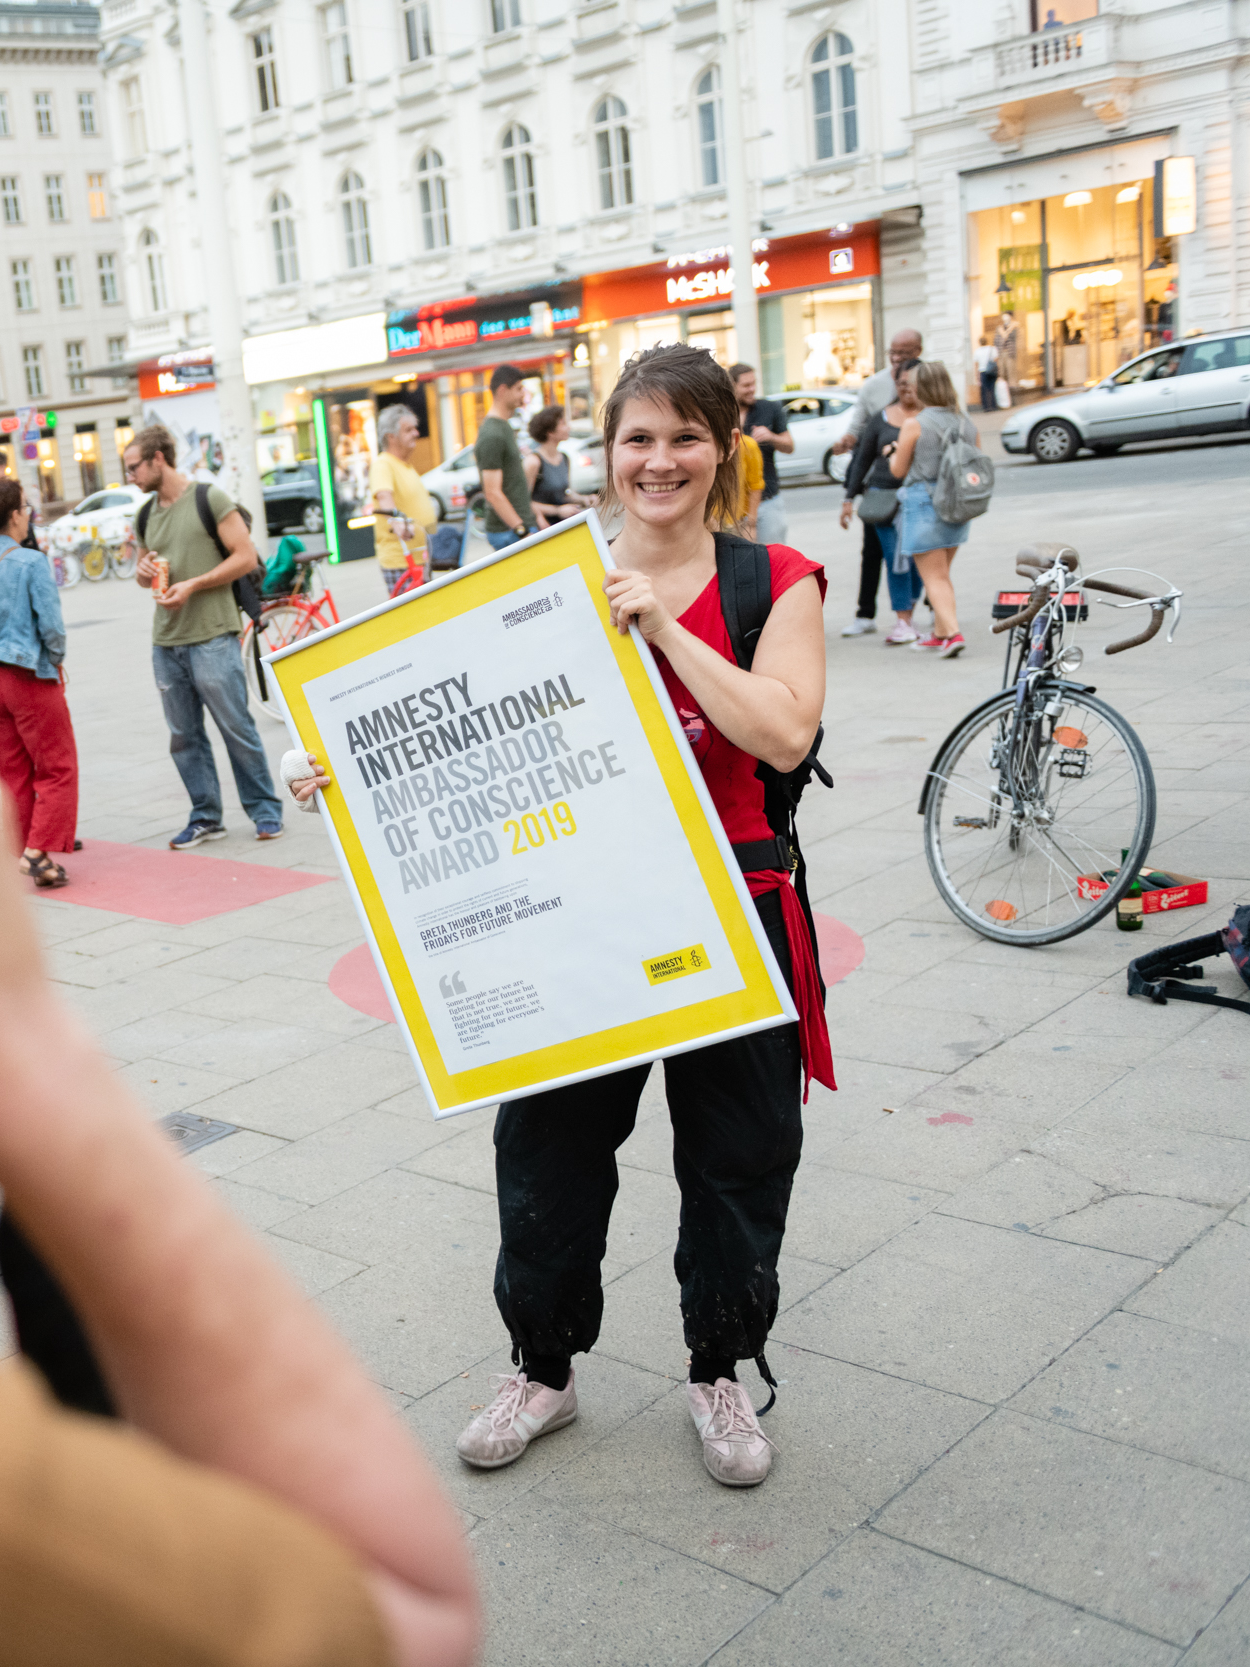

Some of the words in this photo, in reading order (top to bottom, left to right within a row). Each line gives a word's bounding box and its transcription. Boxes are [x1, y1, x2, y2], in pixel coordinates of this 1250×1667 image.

[666, 261, 771, 304] McSHAK
[388, 326, 421, 351] Der
[417, 318, 478, 348] Mann
[480, 321, 506, 335] der
[508, 306, 579, 330] verhnt
[502, 599, 543, 623] AMBASSADOR
[509, 606, 545, 627] CONSCIENCE
[541, 596, 553, 612] 2019
[329, 691, 347, 702] AMNESTY
[346, 677, 379, 695] INTERNATIONAL'S
[378, 669, 396, 681] HIGHEST
[395, 662, 413, 673] HONOUR
[345, 671, 473, 755] AMNESTY
[355, 673, 586, 789] INTERNATIONAL
[371, 720, 572, 825] AMBASSADOR
[383, 815, 419, 857] OF
[427, 740, 626, 841] CONSCIENCE
[398, 830, 500, 895] AWARD
[503, 801, 577, 855] 2019
[419, 924, 448, 941] GRETA
[446, 908, 494, 931] THUNBERG
[494, 901, 513, 916] AND
[513, 895, 532, 909] THE
[423, 931, 459, 952] FRIDAYS
[459, 925, 479, 939] FOR
[478, 913, 514, 933] FUTURE
[514, 896, 562, 921] MOVEMENT
[650, 955, 683, 973] AMNESTY
[652, 965, 686, 979] INTERNATIONAL
[445, 999, 464, 1008] Some
[465, 991, 487, 1004] people
[513, 979, 524, 987] are
[448, 1003, 475, 1015] fighting
[475, 999, 486, 1007] for
[487, 995, 499, 1003] our
[499, 989, 521, 999] future
[521, 984, 535, 992] but
[451, 1014, 465, 1022] that
[473, 1007, 485, 1016] not
[485, 1003, 502, 1012] true,
[526, 991, 538, 999] not
[454, 1017, 481, 1030] fighting
[492, 1010, 504, 1018] our
[505, 1003, 529, 1014] future,
[457, 1029, 468, 1037] are
[468, 1021, 496, 1033] fighting
[495, 1017, 506, 1025] for
